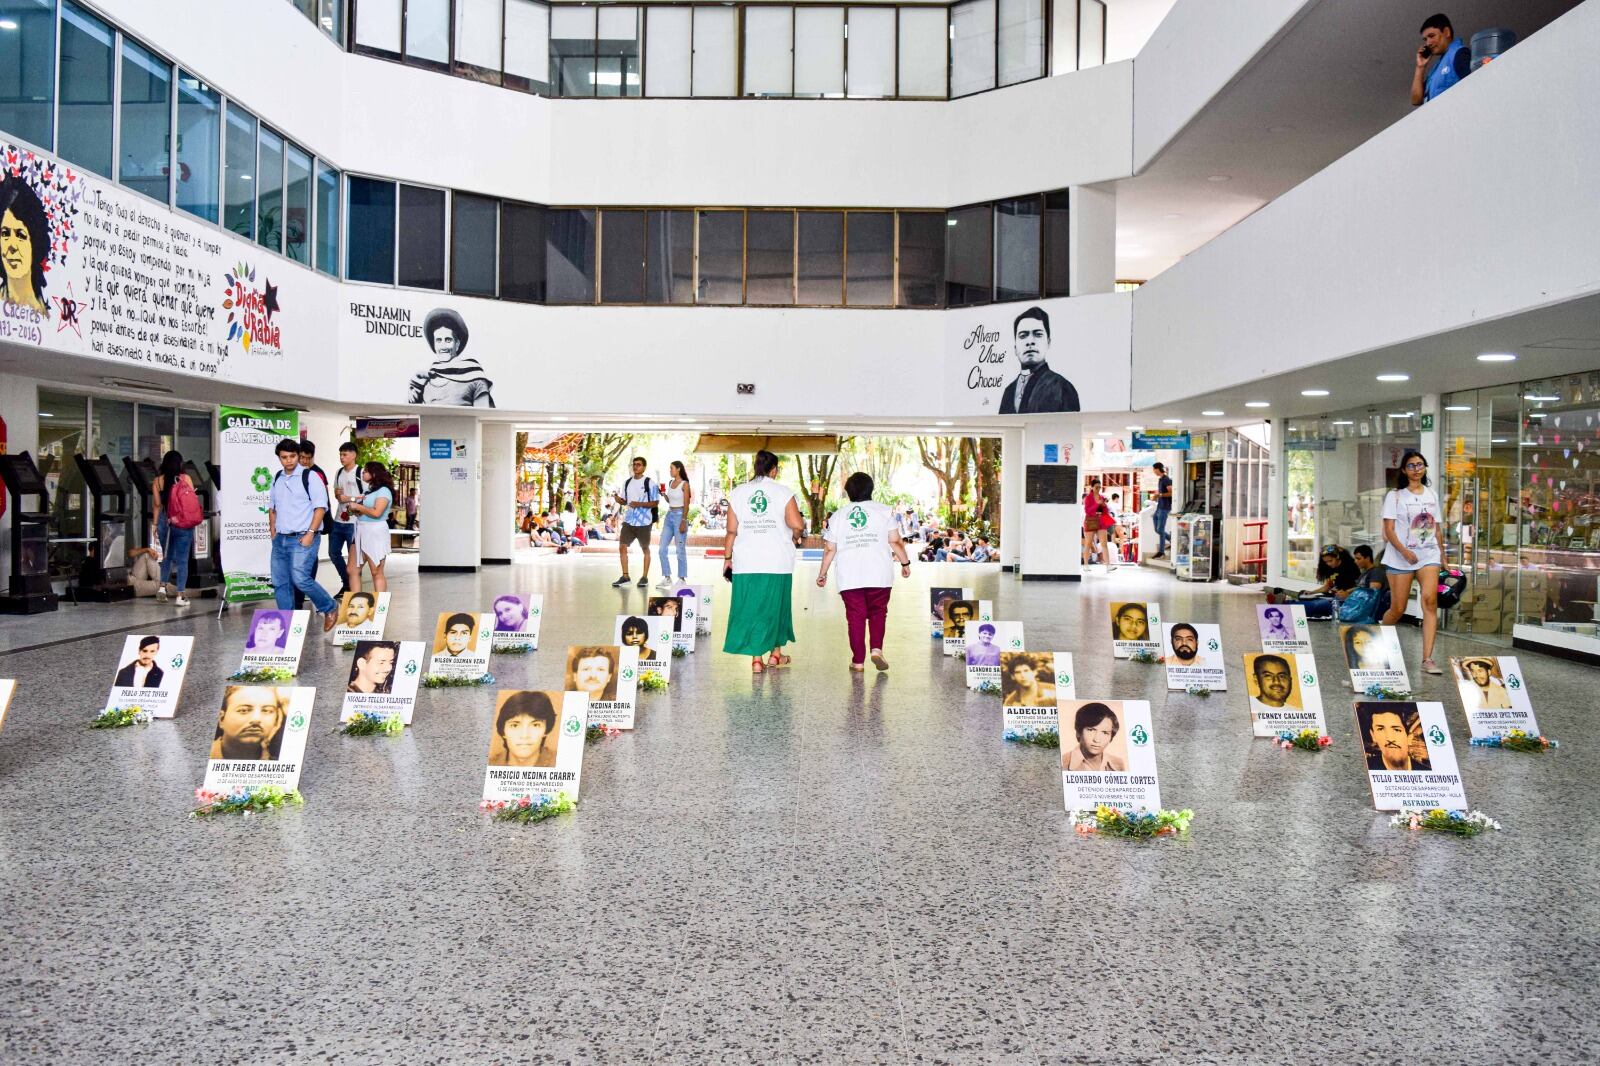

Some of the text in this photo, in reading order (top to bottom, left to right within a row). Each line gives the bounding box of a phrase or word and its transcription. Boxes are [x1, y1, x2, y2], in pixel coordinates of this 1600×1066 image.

[84, 211, 92, 224] no
[94, 214, 99, 228] le
[102, 220, 111, 234] voy
[124, 229, 140, 241] pedir
[82, 235, 106, 256] porque
[109, 244, 116, 256] yo
[119, 243, 136, 263] estoy
[140, 252, 172, 272] rompiendo
[176, 264, 185, 278] por
[82, 256, 87, 269] y
[90, 253, 95, 268] la
[97, 261, 108, 278] que
[134, 270, 156, 289] romper
[159, 277, 170, 293] que
[86, 274, 215, 322] y la que quiera quemar que queme
[91, 297, 95, 310] y
[98, 295, 107, 310] la
[111, 304, 122, 322] que
[350, 302, 411, 322] BENJAMIN
[90, 319, 112, 337] porque
[116, 323, 135, 339] antes
[137, 327, 147, 341] de
[150, 331, 160, 347] que
[250, 312, 281, 350] Rabia
[366, 320, 423, 338] DINDICUE
[92, 337, 103, 352] han
[107, 342, 143, 360] asesinado
[147, 350, 151, 362] a
[227, 417, 292, 430] GALERIA DE
[225, 431, 240, 443] LA
[211, 763, 296, 773] JHON FABER CALVACHE
[489, 770, 520, 779] TARSICIO
[521, 771, 547, 780] MEDINA
[1066, 773, 1156, 785] LEONARDO GÓMEZ CORTES
[1371, 774, 1392, 783] TULIO
[1393, 774, 1423, 785] ENRIQUE
